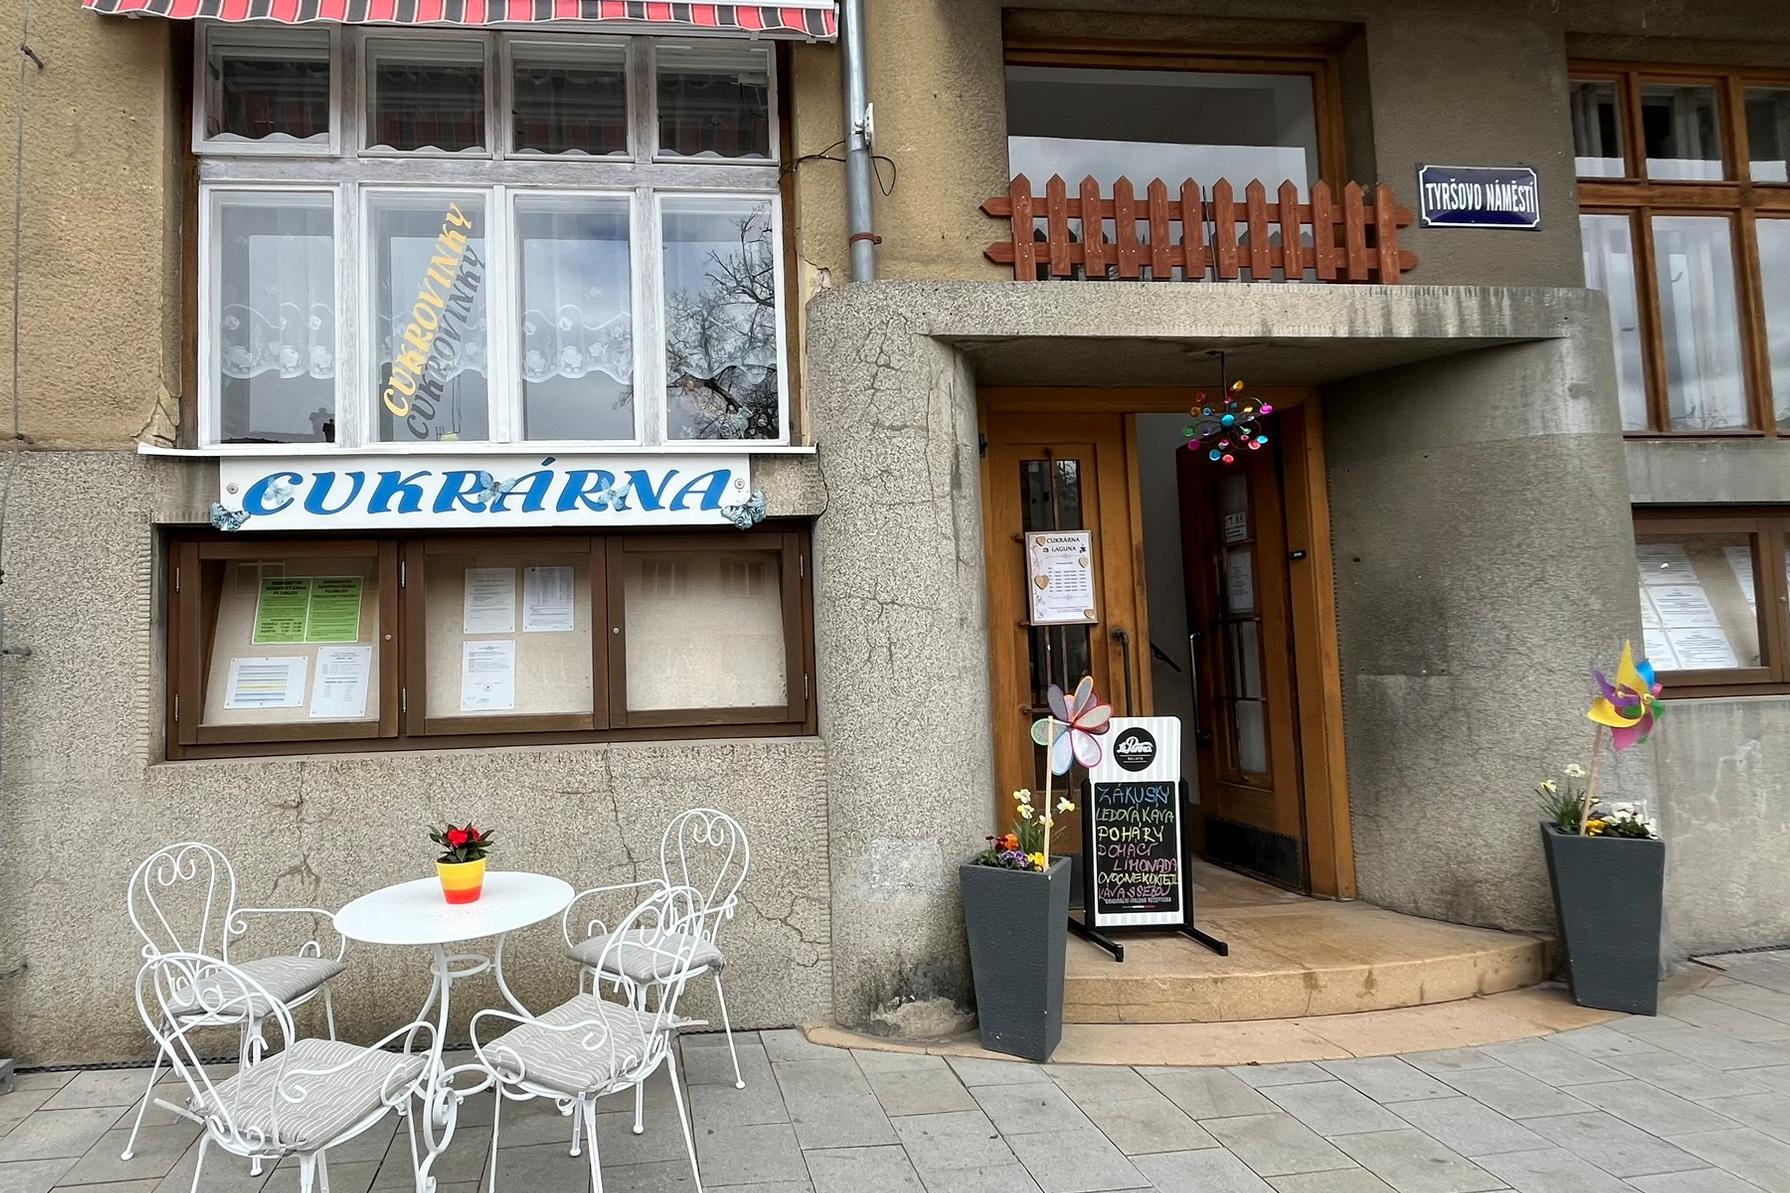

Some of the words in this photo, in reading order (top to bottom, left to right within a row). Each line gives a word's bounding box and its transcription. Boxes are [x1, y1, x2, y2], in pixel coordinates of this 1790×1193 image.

[1425, 178, 1482, 210] TYRŠOVO
[1486, 179, 1535, 213] NÁMĚSTÍ
[384, 202, 472, 417] CUKROVINKY
[406, 245, 486, 440] CUKROVINKY
[241, 457, 732, 516] CUKRÁRNA
[1051, 545, 1077, 553] LAGUNA
[1097, 783, 1170, 805] ZÁKUSKY
[1097, 822, 1164, 842] POHÁRY
